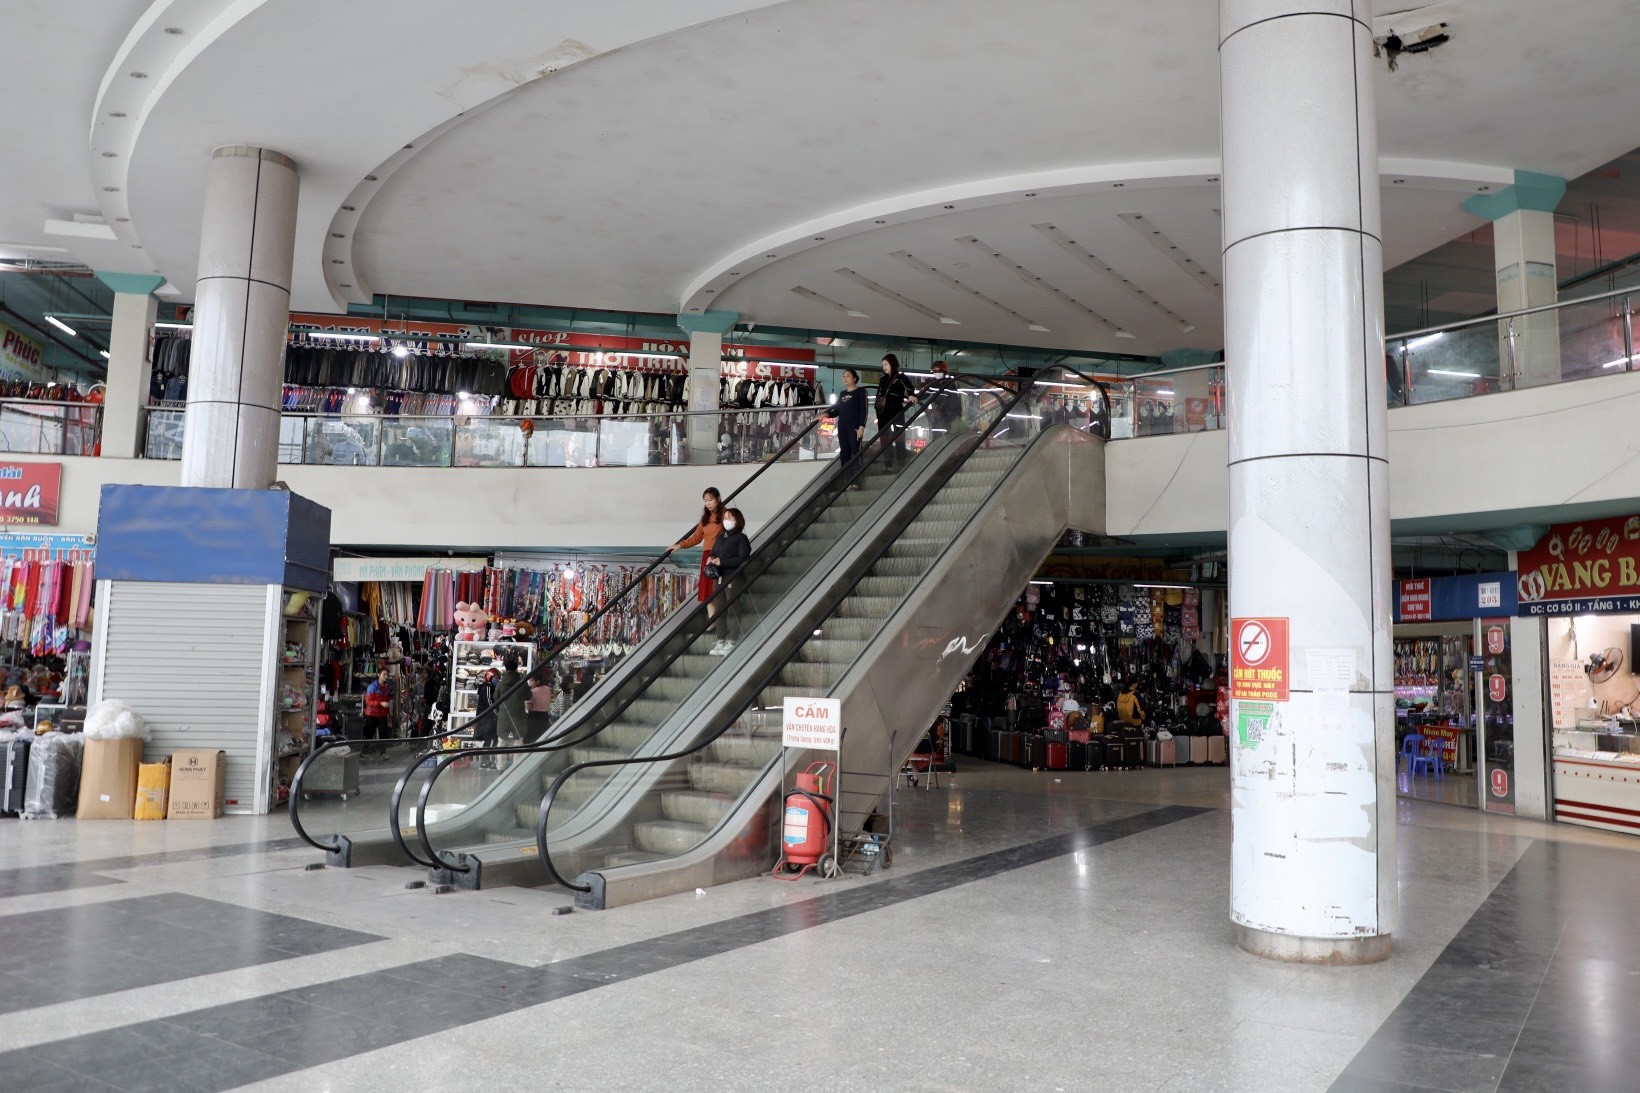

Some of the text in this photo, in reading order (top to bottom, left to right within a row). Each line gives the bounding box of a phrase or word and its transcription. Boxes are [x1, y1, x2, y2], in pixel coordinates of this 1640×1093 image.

[3, 329, 40, 364] Phúc
[755, 361, 772, 376] &
[1540, 556, 1640, 592] VÀNG B
[1546, 602, 1559, 613] CƠ
[1560, 599, 1573, 612] SỞ
[1587, 598, 1613, 611] TẦNG
[1616, 600, 1621, 610] 1
[1243, 667, 1256, 680] HÚT
[1257, 666, 1282, 681] THUỐC
[795, 703, 828, 718] CẤM
[1488, 627, 1508, 797] 9 9 9
